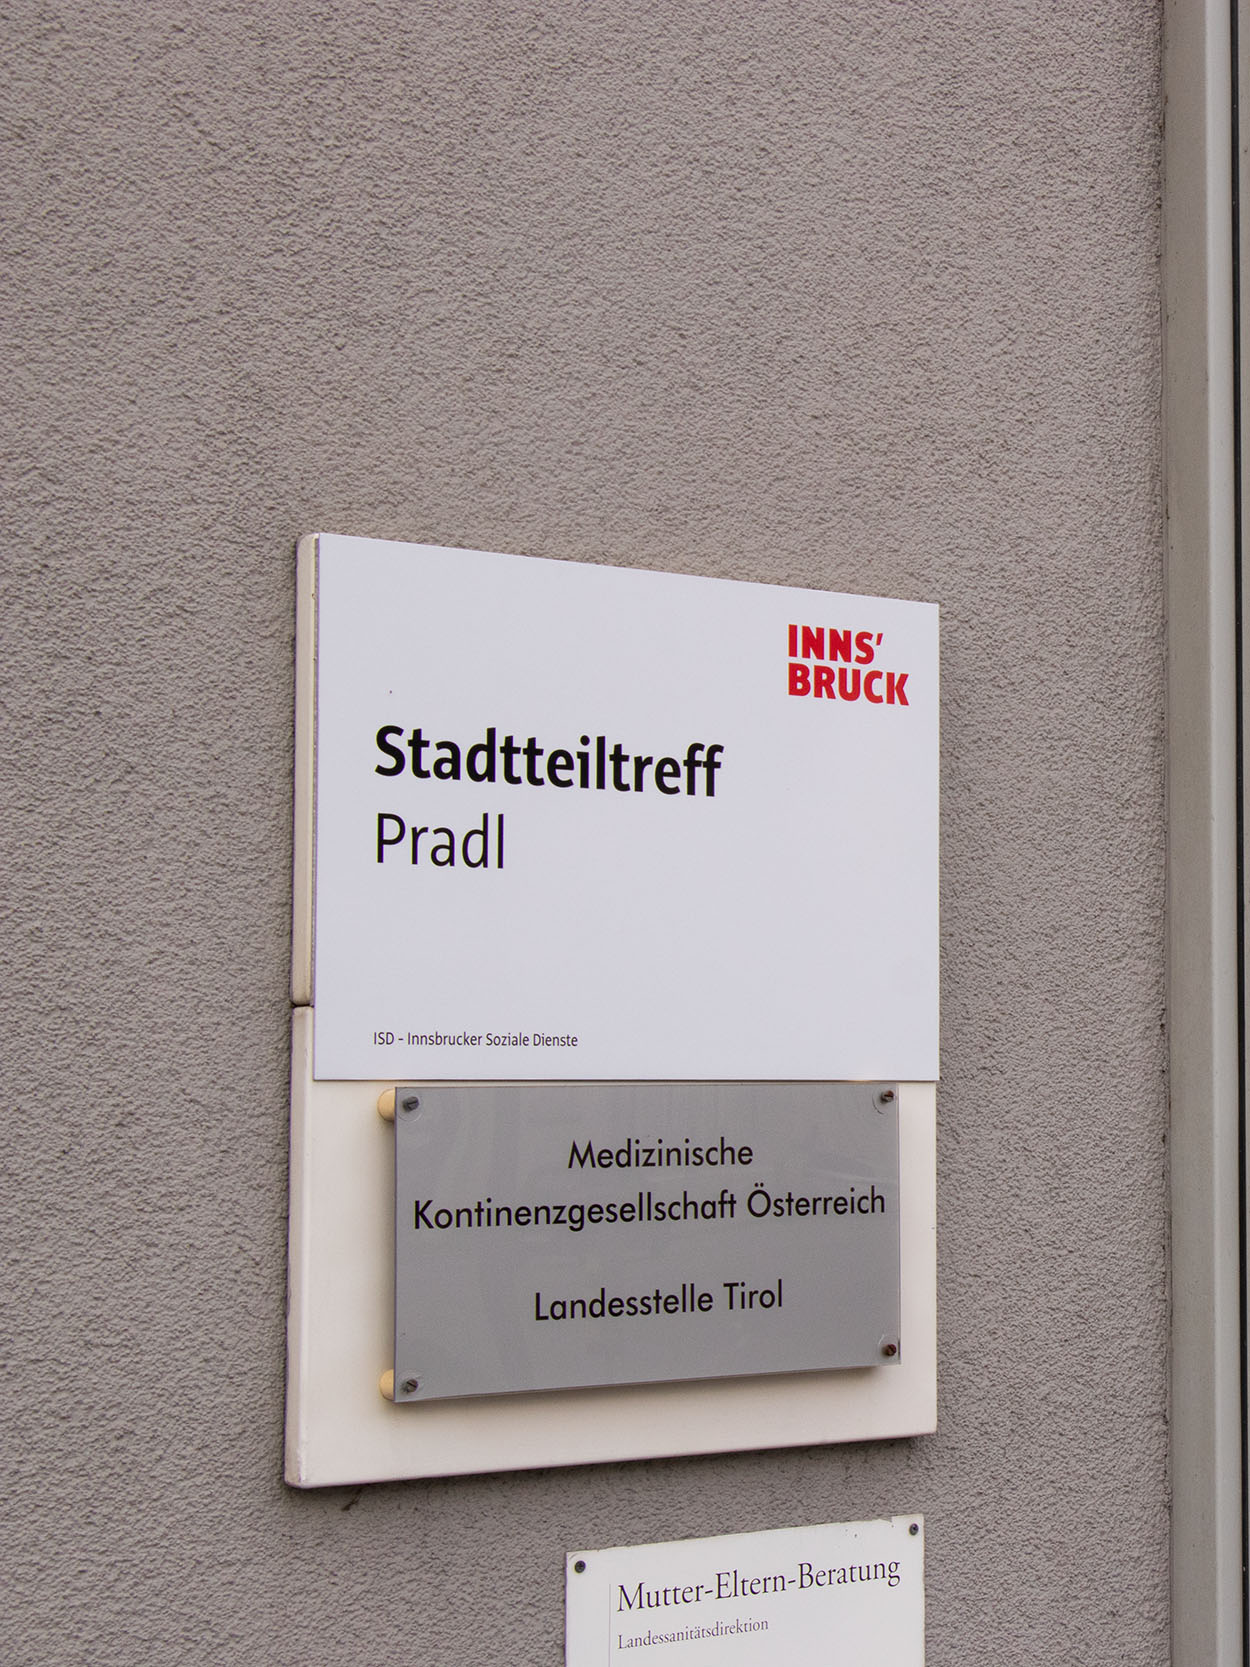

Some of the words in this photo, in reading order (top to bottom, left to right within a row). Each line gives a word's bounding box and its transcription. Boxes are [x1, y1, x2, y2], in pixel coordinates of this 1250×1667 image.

[788, 661, 910, 707] BRUCK
[374, 724, 725, 798] Stadtteiltreff
[376, 812, 505, 870] Pradl
[373, 1031, 395, 1046] ISD
[407, 1031, 483, 1047] Innsbrucker
[485, 1032, 530, 1047] Soziale
[532, 1032, 579, 1047] Dienste
[567, 1136, 754, 1169] Medizinische
[414, 1188, 737, 1233] Kontinenzgesellschaft
[747, 1182, 886, 1218] Österreich
[535, 1282, 714, 1321] Landesstelle
[722, 1278, 783, 1311] Tirol
[617, 1561, 901, 1613] Mutter-Eltern-Beratung
[618, 1617, 769, 1650] Landessanitätsdirektion
